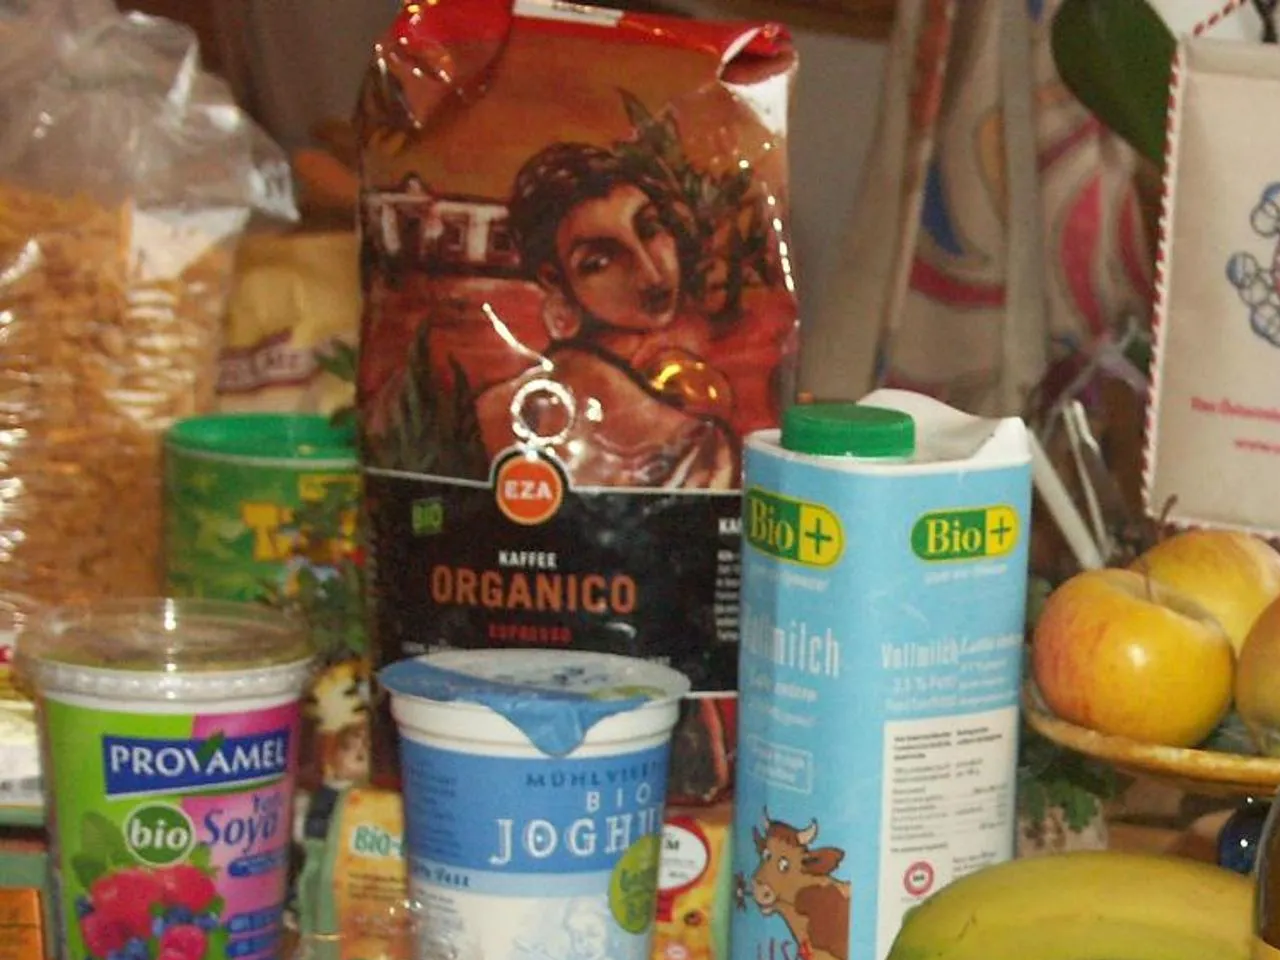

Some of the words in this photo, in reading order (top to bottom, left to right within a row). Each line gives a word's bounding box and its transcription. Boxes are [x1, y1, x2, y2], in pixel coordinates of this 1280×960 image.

[505, 480, 553, 500] EZA
[752, 496, 795, 551] Bio
[926, 517, 983, 554] Bio
[499, 550, 557, 569] KAFFEE
[430, 564, 638, 615] ORGANICO
[110, 739, 286, 777] PROVAMEL
[130, 819, 190, 851] bio
